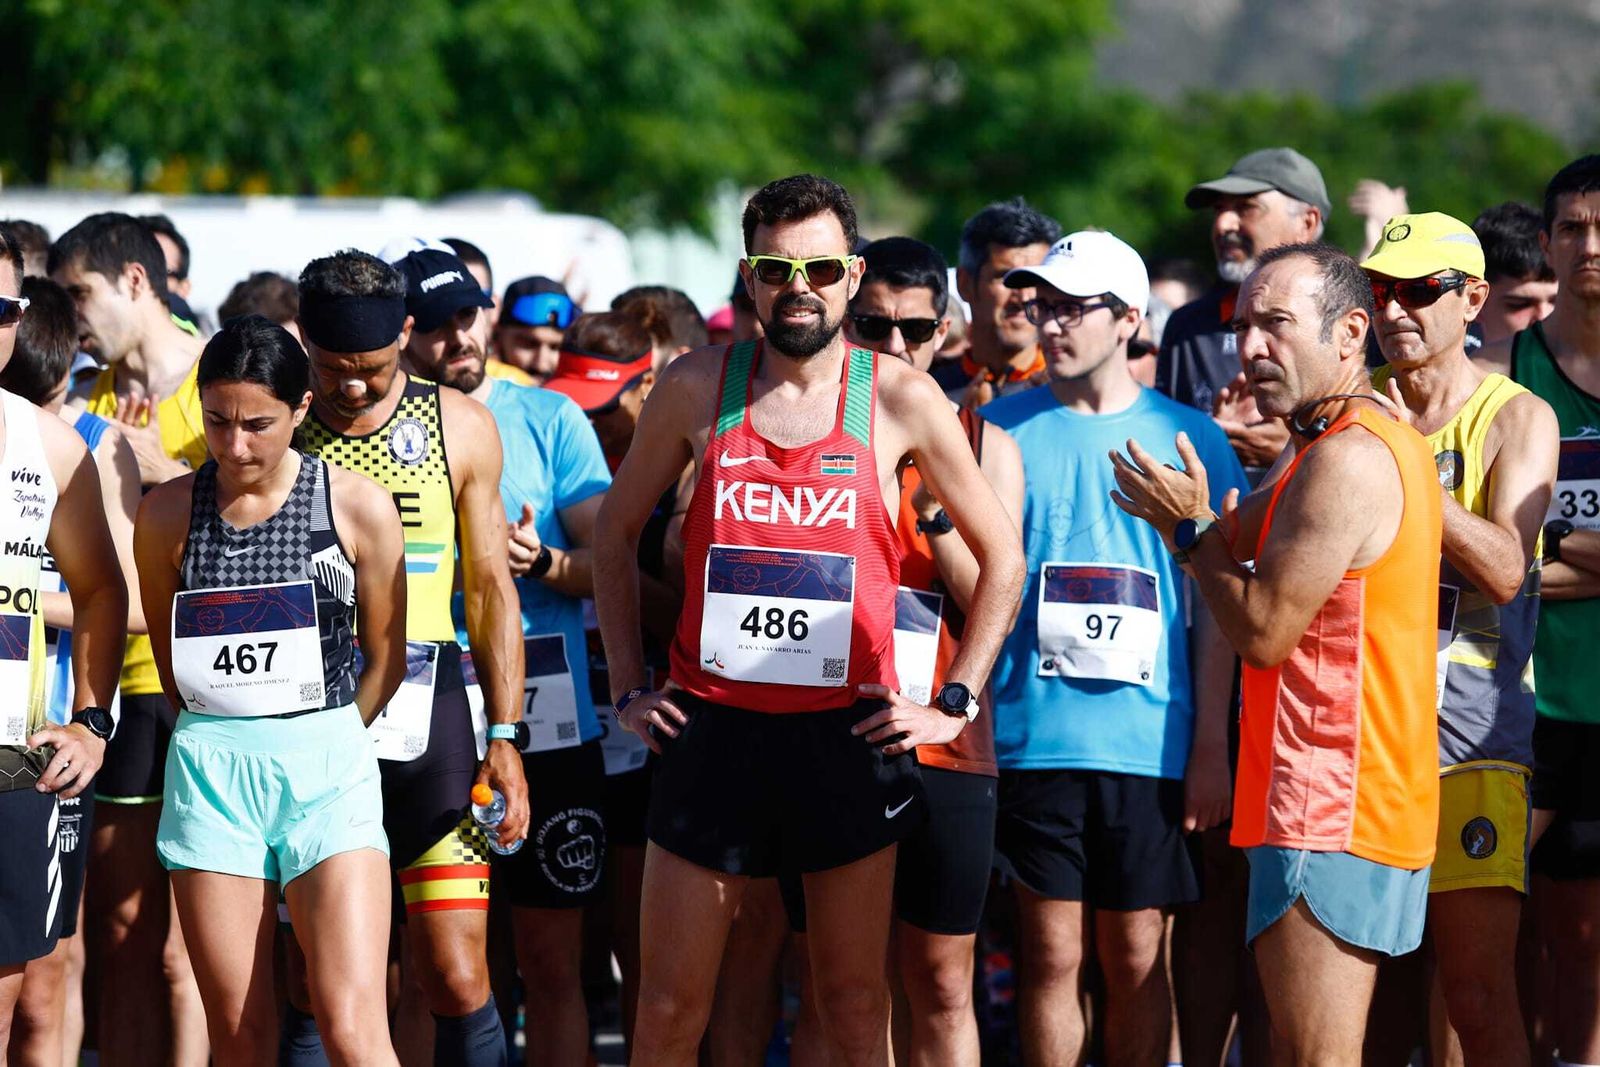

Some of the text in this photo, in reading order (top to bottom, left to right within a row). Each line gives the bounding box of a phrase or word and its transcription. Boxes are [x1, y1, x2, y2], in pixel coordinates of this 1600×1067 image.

[714, 480, 857, 529] KENYA
[740, 606, 809, 641] 486
[1086, 614, 1123, 640] 97
[213, 642, 278, 675] 467
[761, 645, 792, 653] NAVARRO
[236, 680, 262, 688] MORENO
